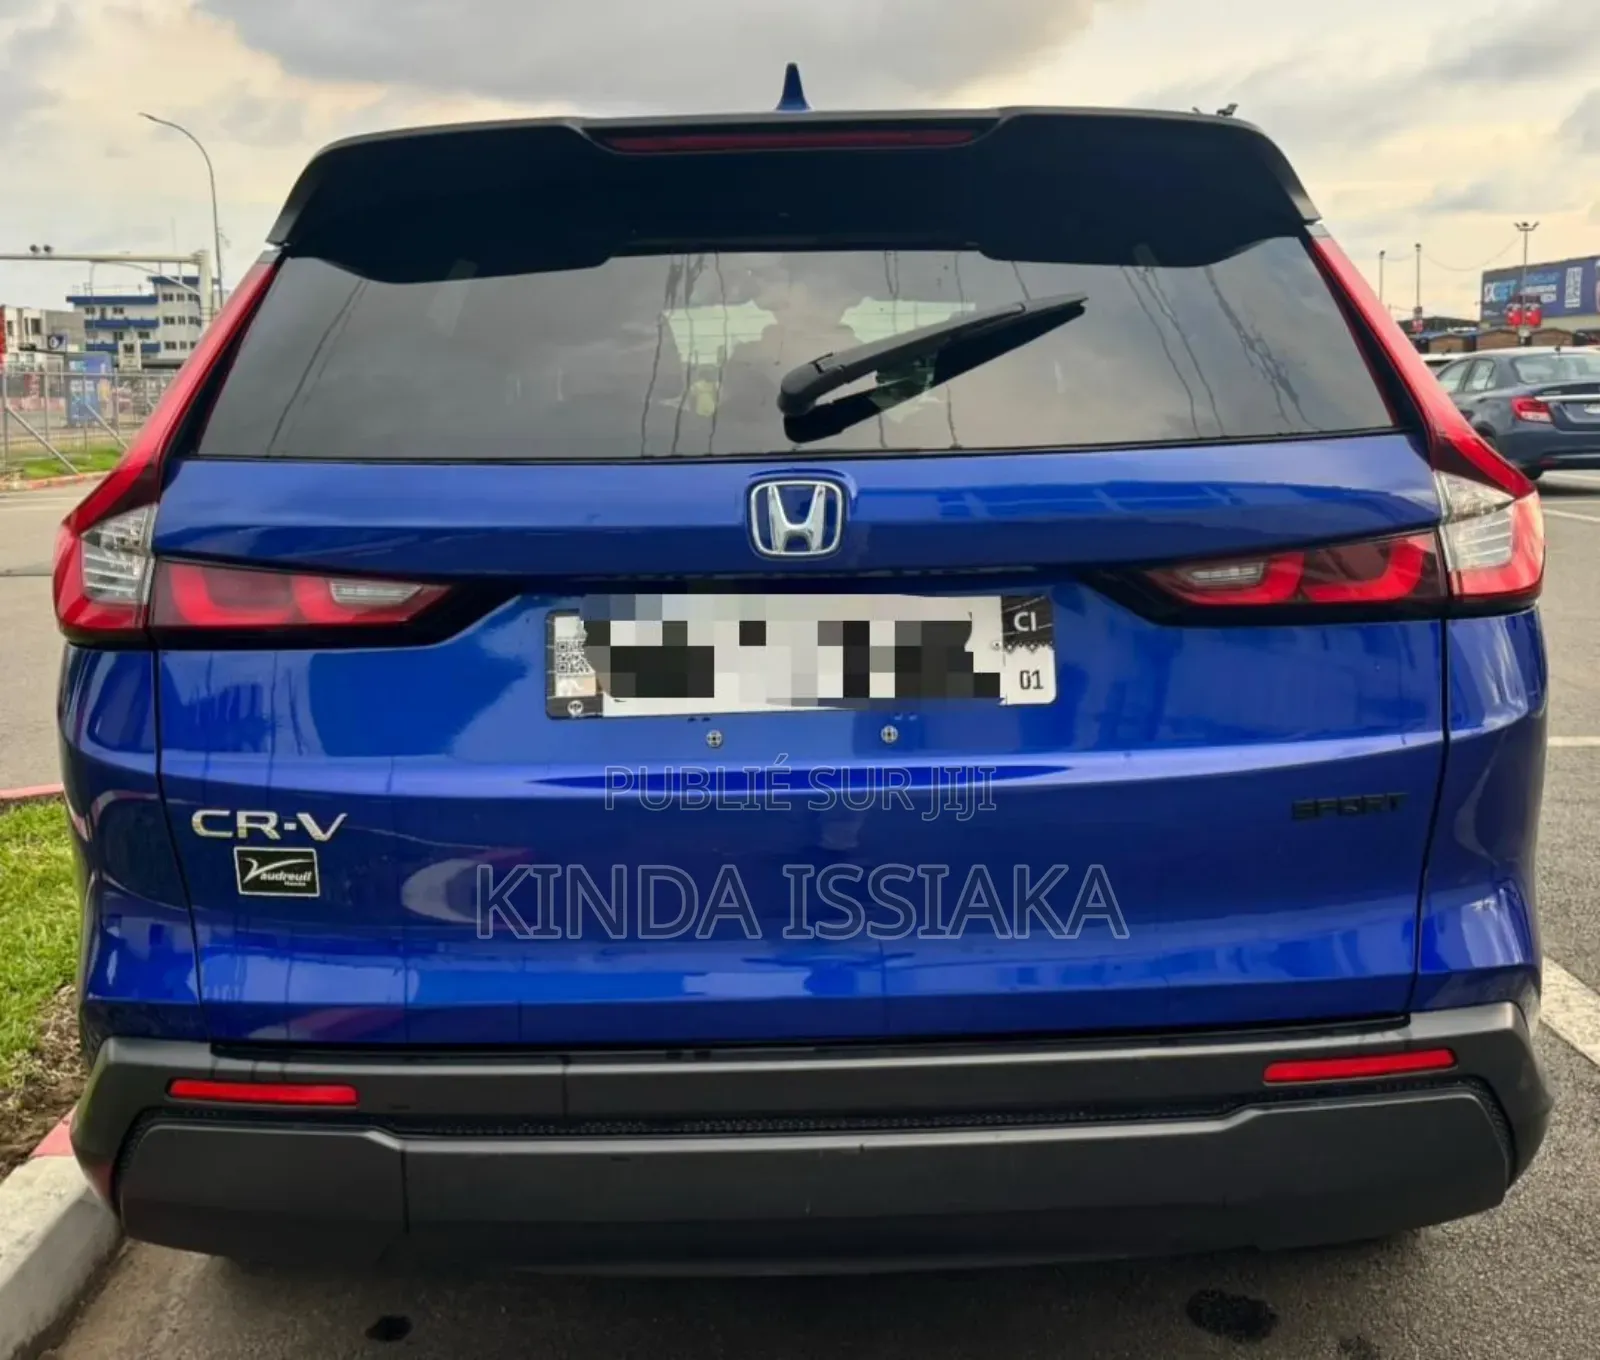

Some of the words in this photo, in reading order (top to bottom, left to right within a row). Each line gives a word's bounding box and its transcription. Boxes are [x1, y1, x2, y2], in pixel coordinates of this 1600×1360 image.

[1014, 611, 1037, 632] CI
[1020, 669, 1044, 690] 01
[191, 809, 348, 842] CR-V
